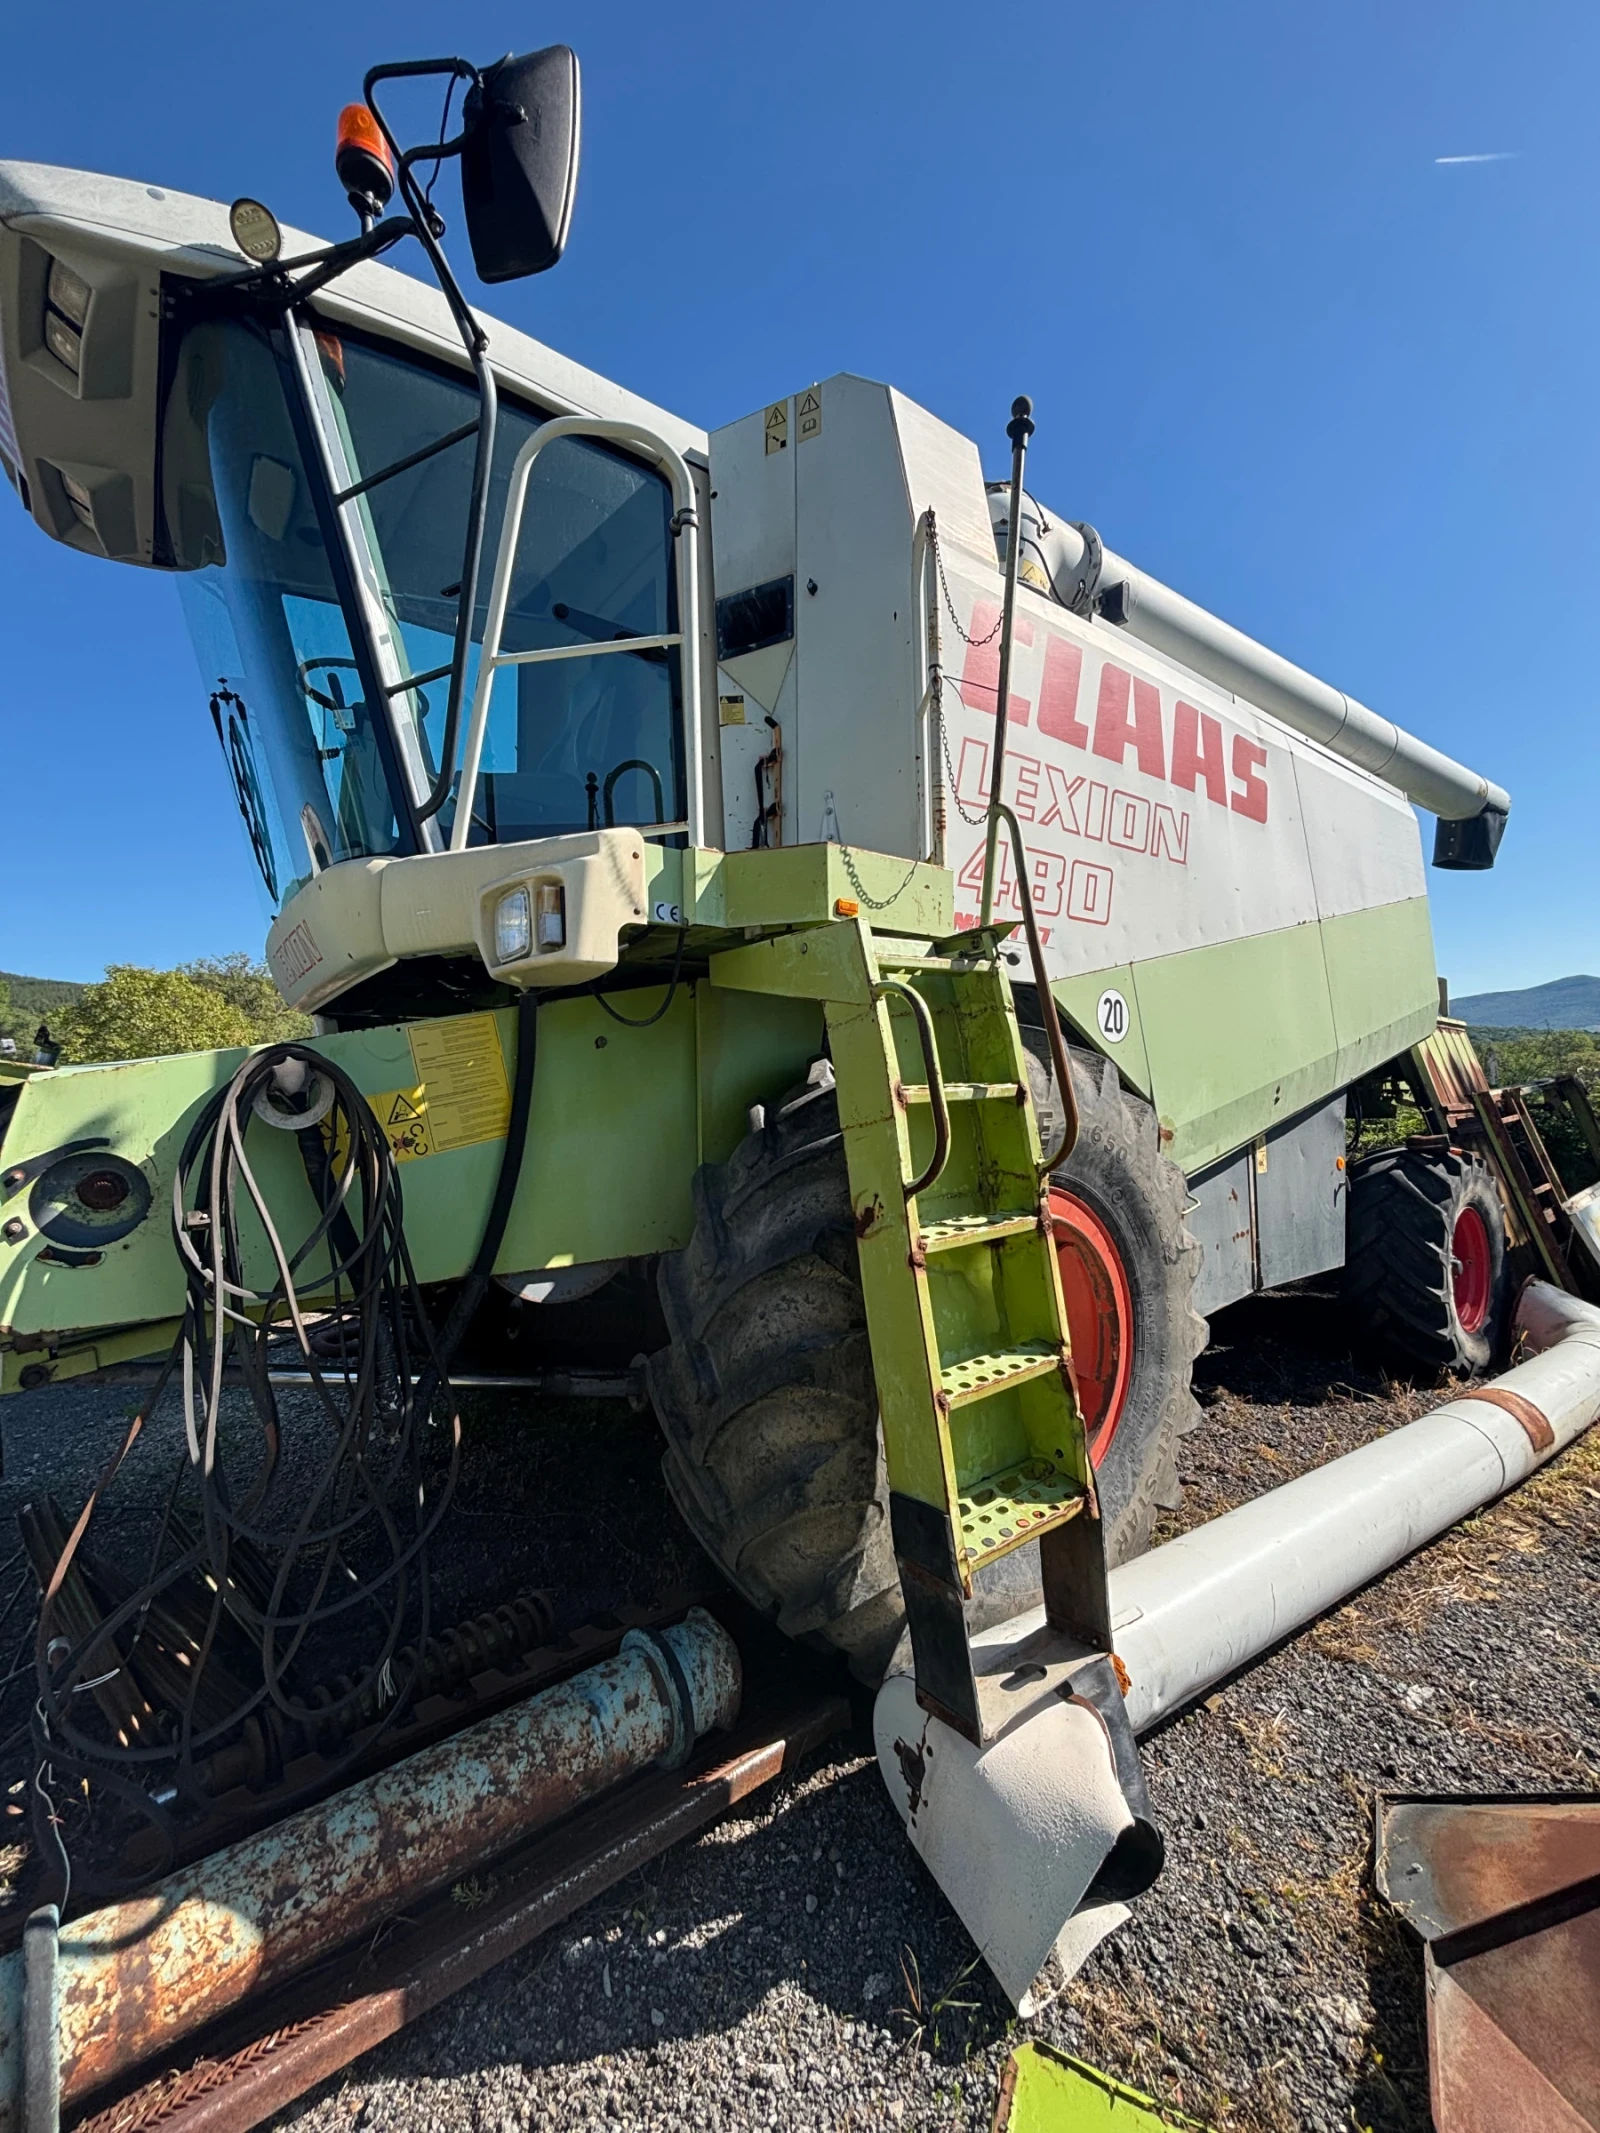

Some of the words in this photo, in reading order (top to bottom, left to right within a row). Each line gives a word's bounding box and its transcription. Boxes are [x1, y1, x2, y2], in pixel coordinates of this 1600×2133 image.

[961, 598, 1268, 824] CLAAS
[956, 737, 1190, 865] LEXION
[656, 903, 679, 922] CE
[957, 838, 1114, 925] 480
[273, 919, 324, 988] EXION
[1103, 997, 1123, 1034] 20
